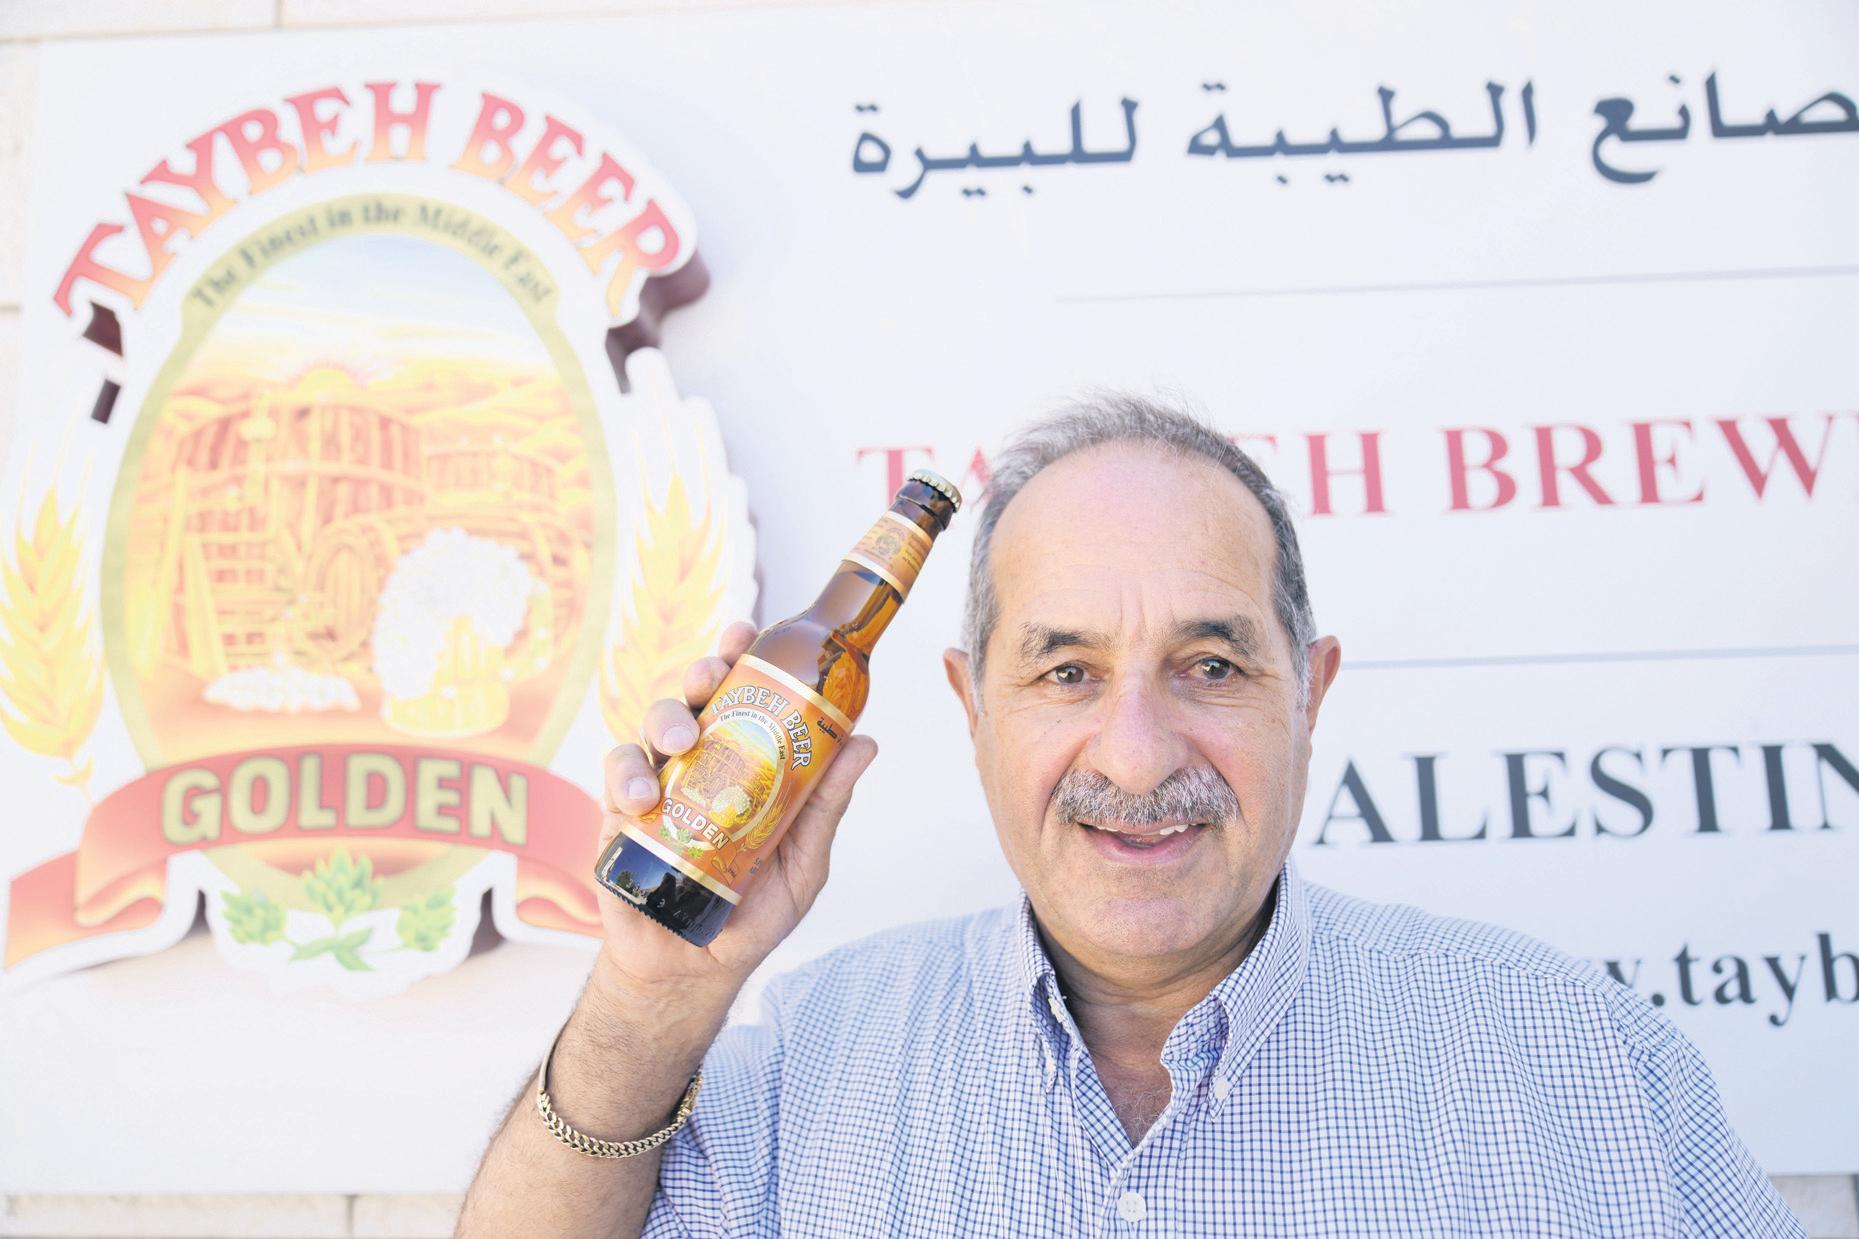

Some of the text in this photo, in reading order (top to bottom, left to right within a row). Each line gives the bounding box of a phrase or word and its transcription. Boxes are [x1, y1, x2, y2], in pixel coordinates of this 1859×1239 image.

[851, 71, 1859, 199] صانع الطيبة للبيرة
[53, 81, 680, 318] TAYBEH BEER
[193, 266, 238, 308] The
[326, 205, 353, 229] in
[361, 202, 405, 225] the
[1442, 410, 1859, 513] BREW
[707, 684, 813, 771] TAYBEH BEER
[720, 712, 731, 722] The
[732, 710, 751, 718] Finest
[758, 714, 769, 727] the
[768, 721, 783, 745] Middle
[161, 751, 530, 846] GOLDEN
[661, 798, 731, 850] GOLDEN
[1313, 742, 1859, 845] ALESTIN
[1583, 931, 1859, 1028] .tayb
